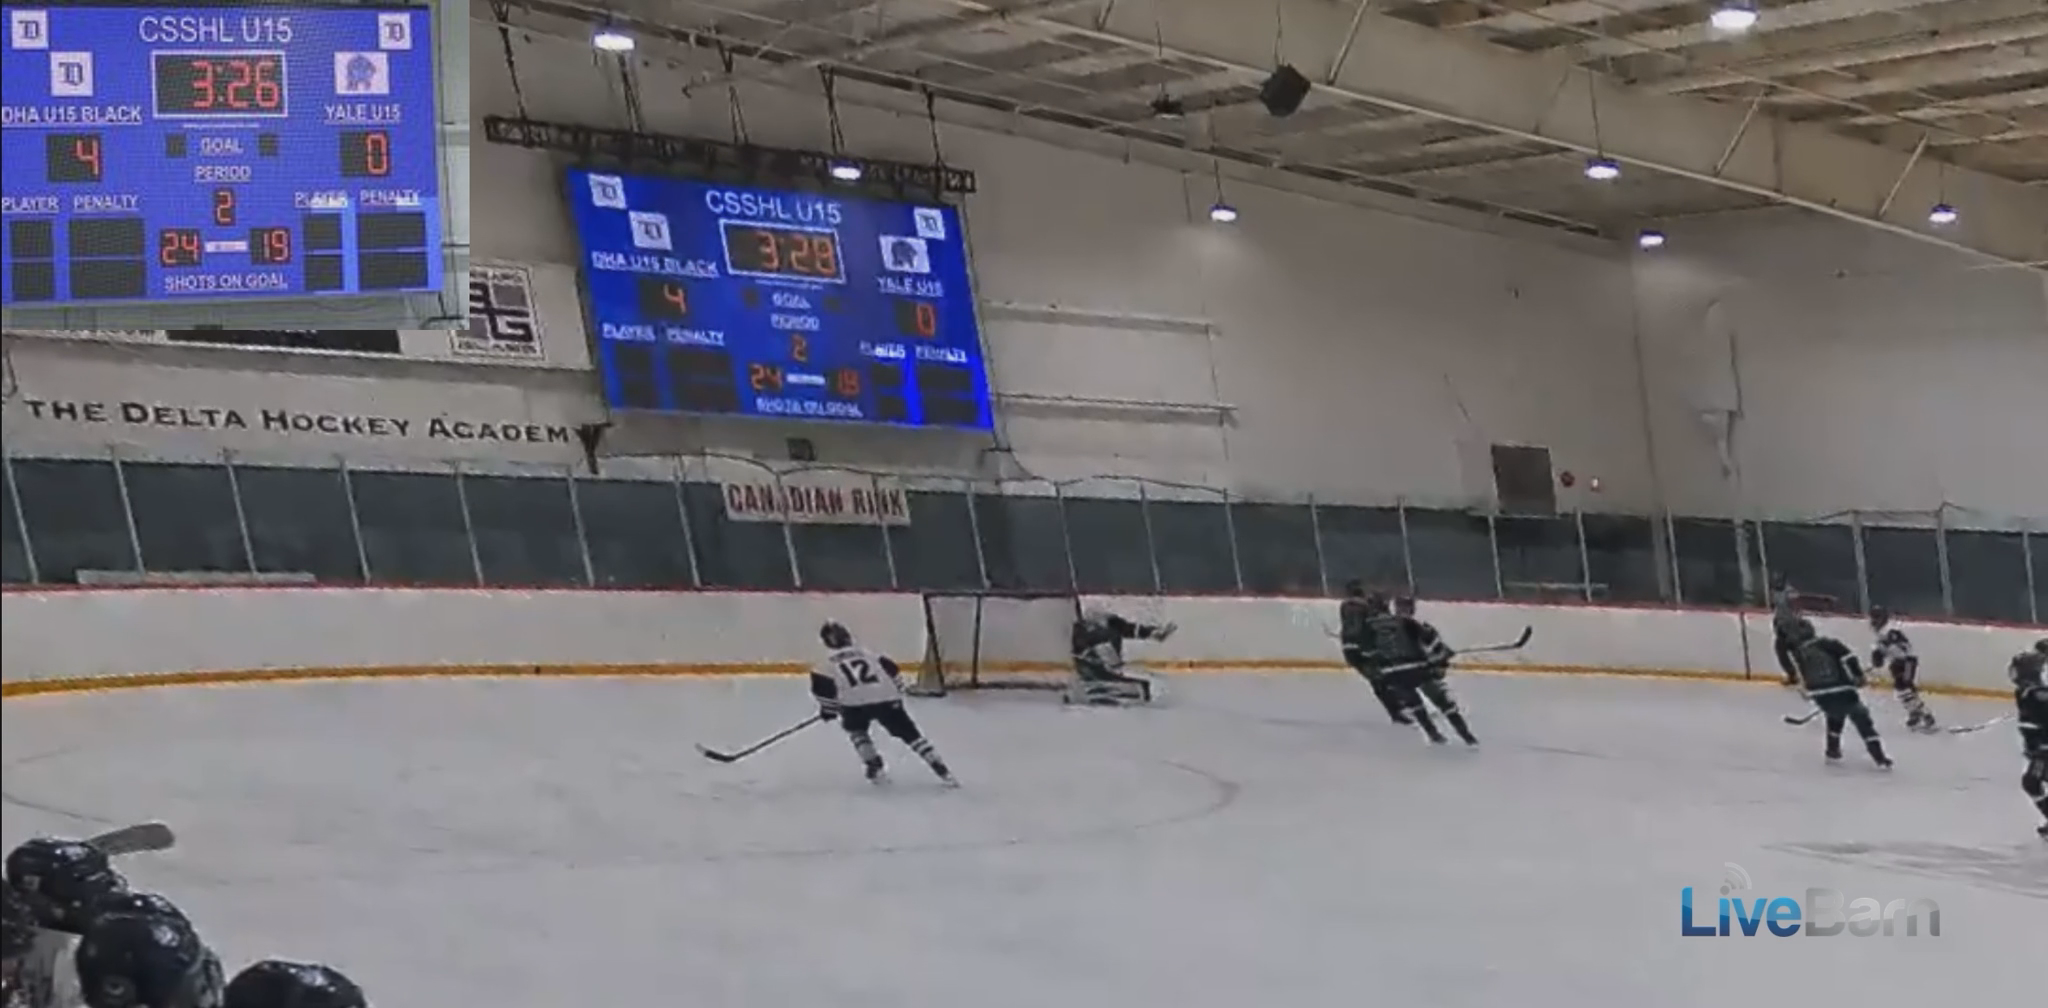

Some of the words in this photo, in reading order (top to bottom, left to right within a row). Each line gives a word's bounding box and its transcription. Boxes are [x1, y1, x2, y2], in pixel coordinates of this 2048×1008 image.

[139, 15, 234, 43] CSSHL
[242, 15, 293, 43] U15
[192, 60, 279, 108] 3:26
[2, 106, 40, 124] DHA
[45, 106, 76, 124] U15
[81, 105, 142, 124] BLACK
[324, 104, 366, 122] YALE
[372, 104, 401, 121] U15
[75, 139, 99, 176] 4
[201, 137, 244, 155] GOAL
[366, 133, 388, 175] 0
[194, 166, 251, 182] PERIOD
[2, 197, 59, 212] PLAYER
[73, 195, 140, 211] PENALTY
[217, 191, 231, 222] 2
[705, 190, 791, 220] CSSHL
[796, 201, 842, 225] U15
[162, 232, 199, 264] 24
[263, 230, 289, 261] 19
[165, 275, 216, 291] SHOTS
[219, 274, 243, 290] ON
[245, 272, 288, 289] GOAL
[876, 276, 914, 294] YALE
[663, 283, 688, 315] 4
[915, 302, 937, 337] 0
[791, 334, 808, 363] 2
[750, 362, 783, 391] 24
[23, 399, 106, 423] THE
[120, 402, 248, 429] DELTA
[260, 408, 410, 437] HOCKEY
[727, 482, 845, 516] CANADIAN
[850, 487, 906, 519] RINK
[839, 658, 880, 689] 12
